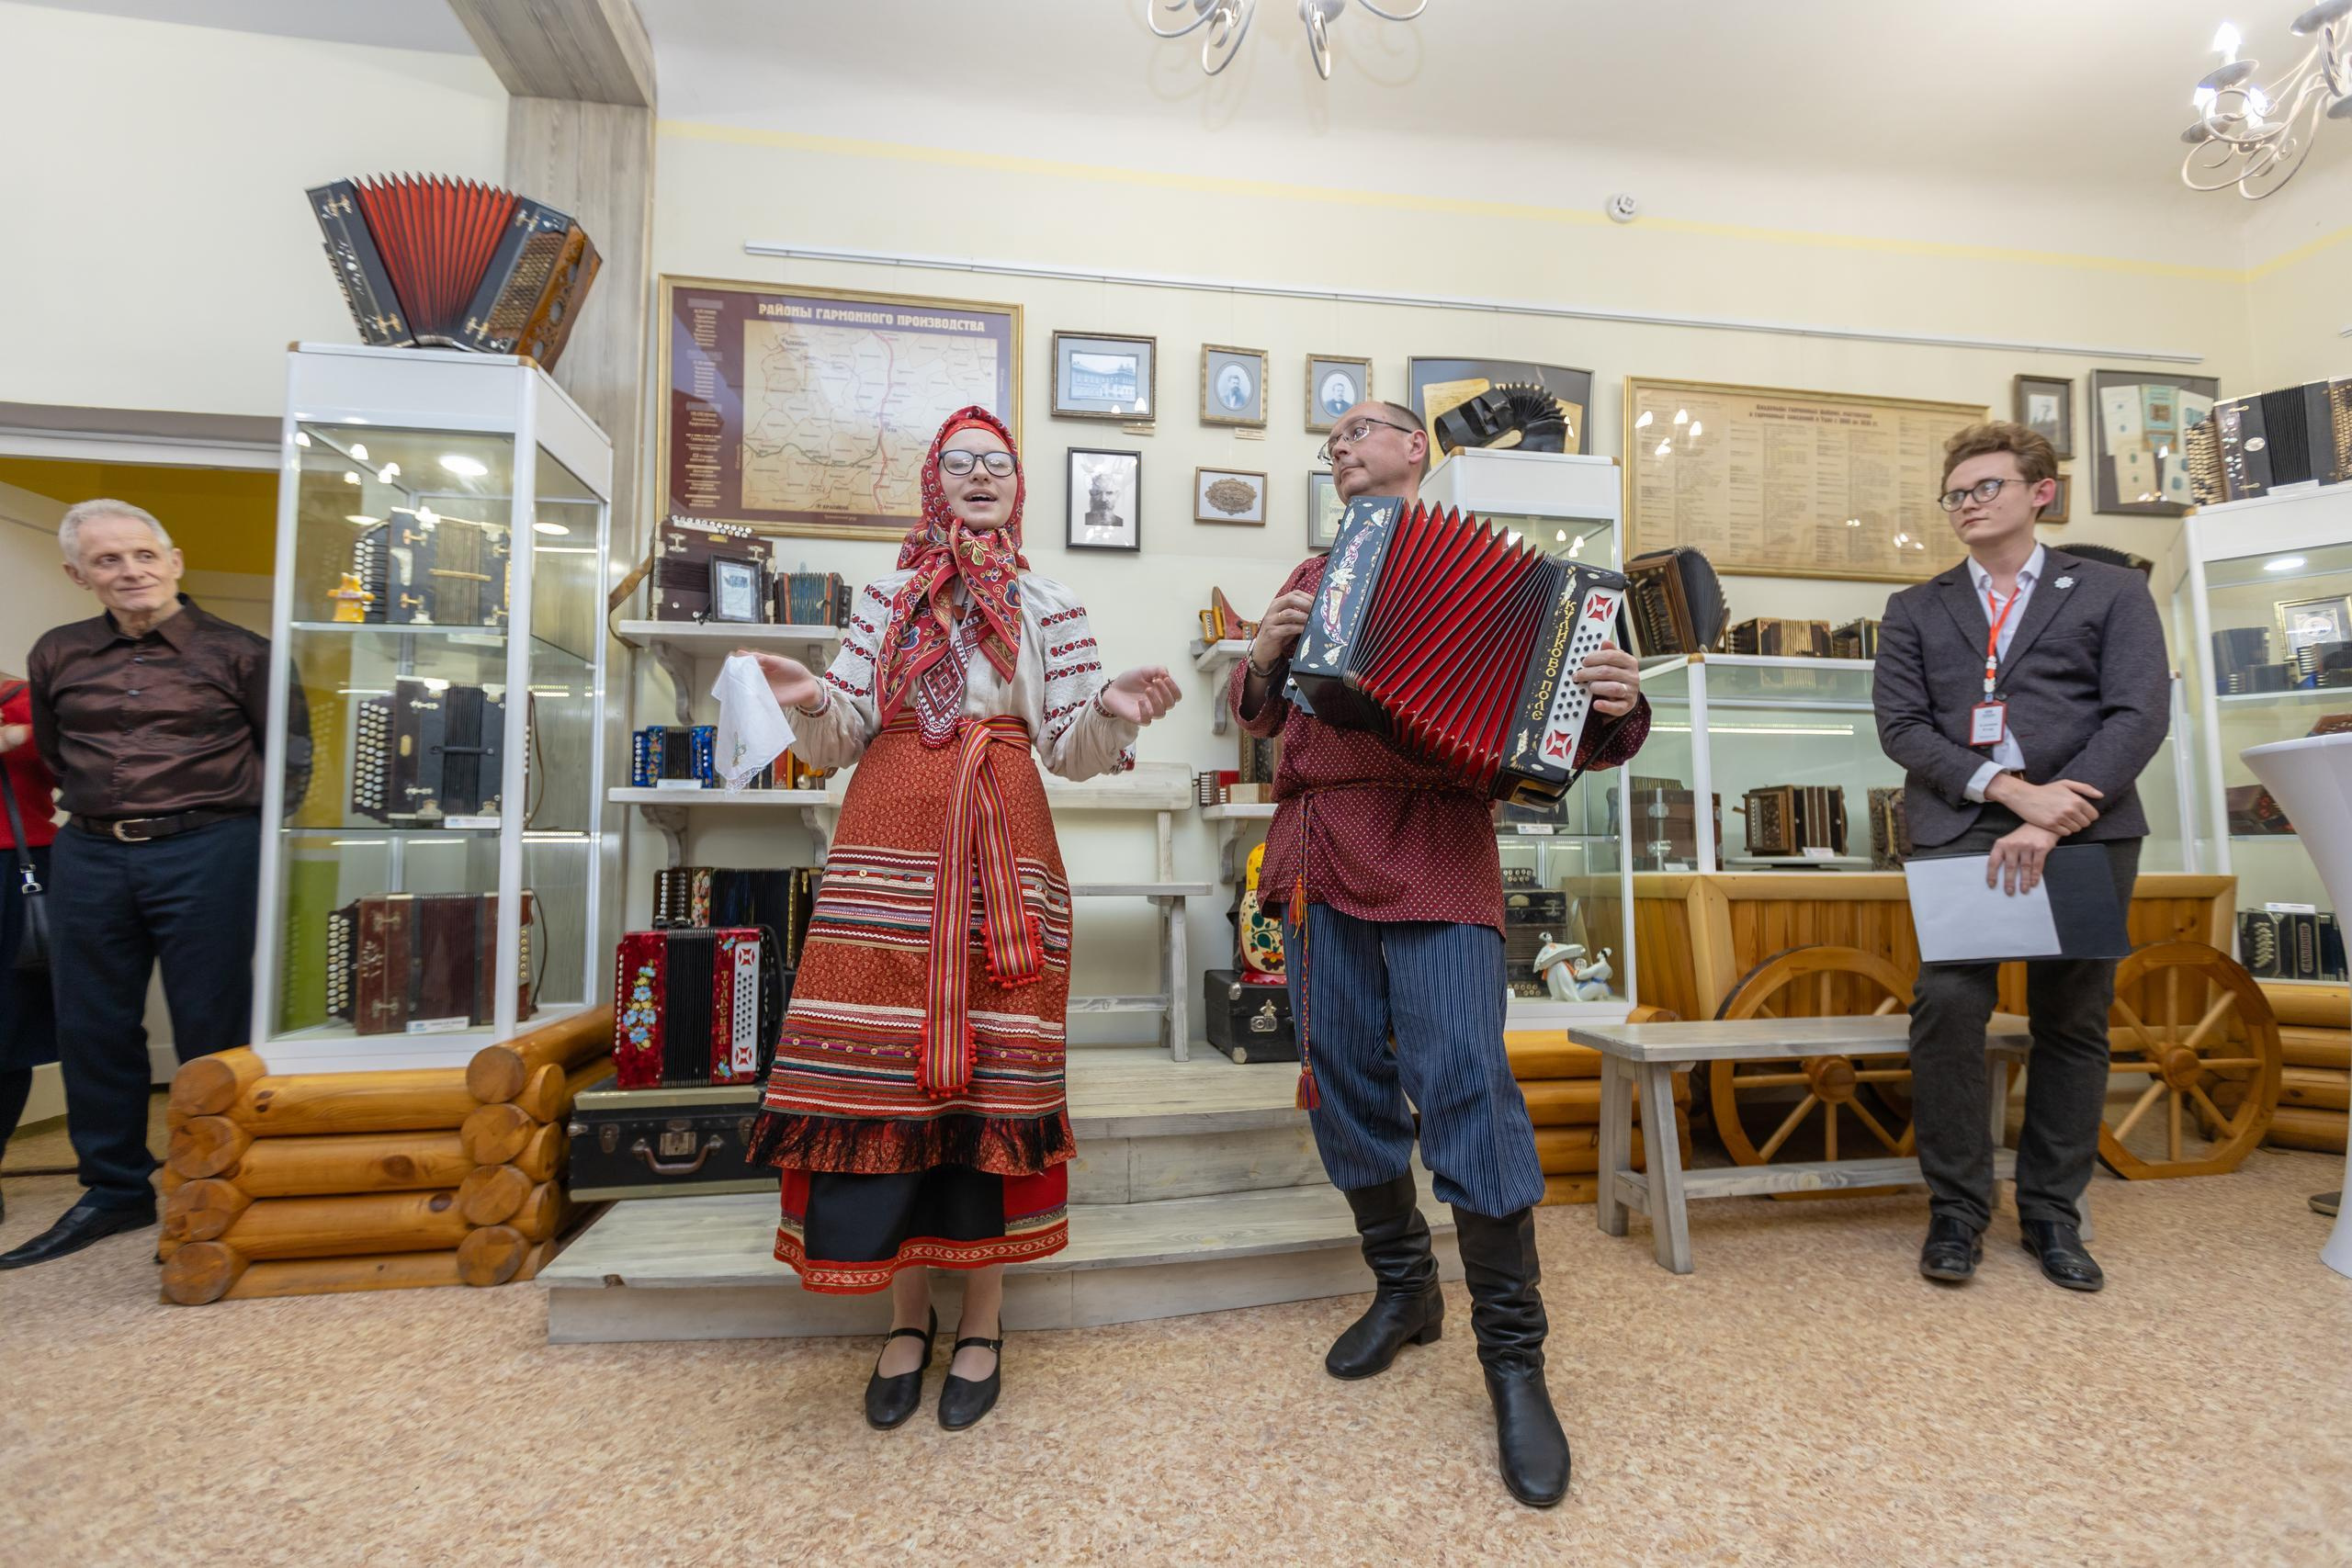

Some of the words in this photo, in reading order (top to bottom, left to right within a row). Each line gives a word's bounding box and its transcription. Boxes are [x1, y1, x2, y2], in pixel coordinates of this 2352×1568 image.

[758, 303, 812, 319] РАЙОНЫ
[816, 309, 893, 325] ГАРМОННОГО
[897, 315, 986, 333] ПРОИЗВОДСТВА
[1545, 601, 1577, 678] КУЛИКОВО
[1532, 680, 1554, 721] ПОЛЕ
